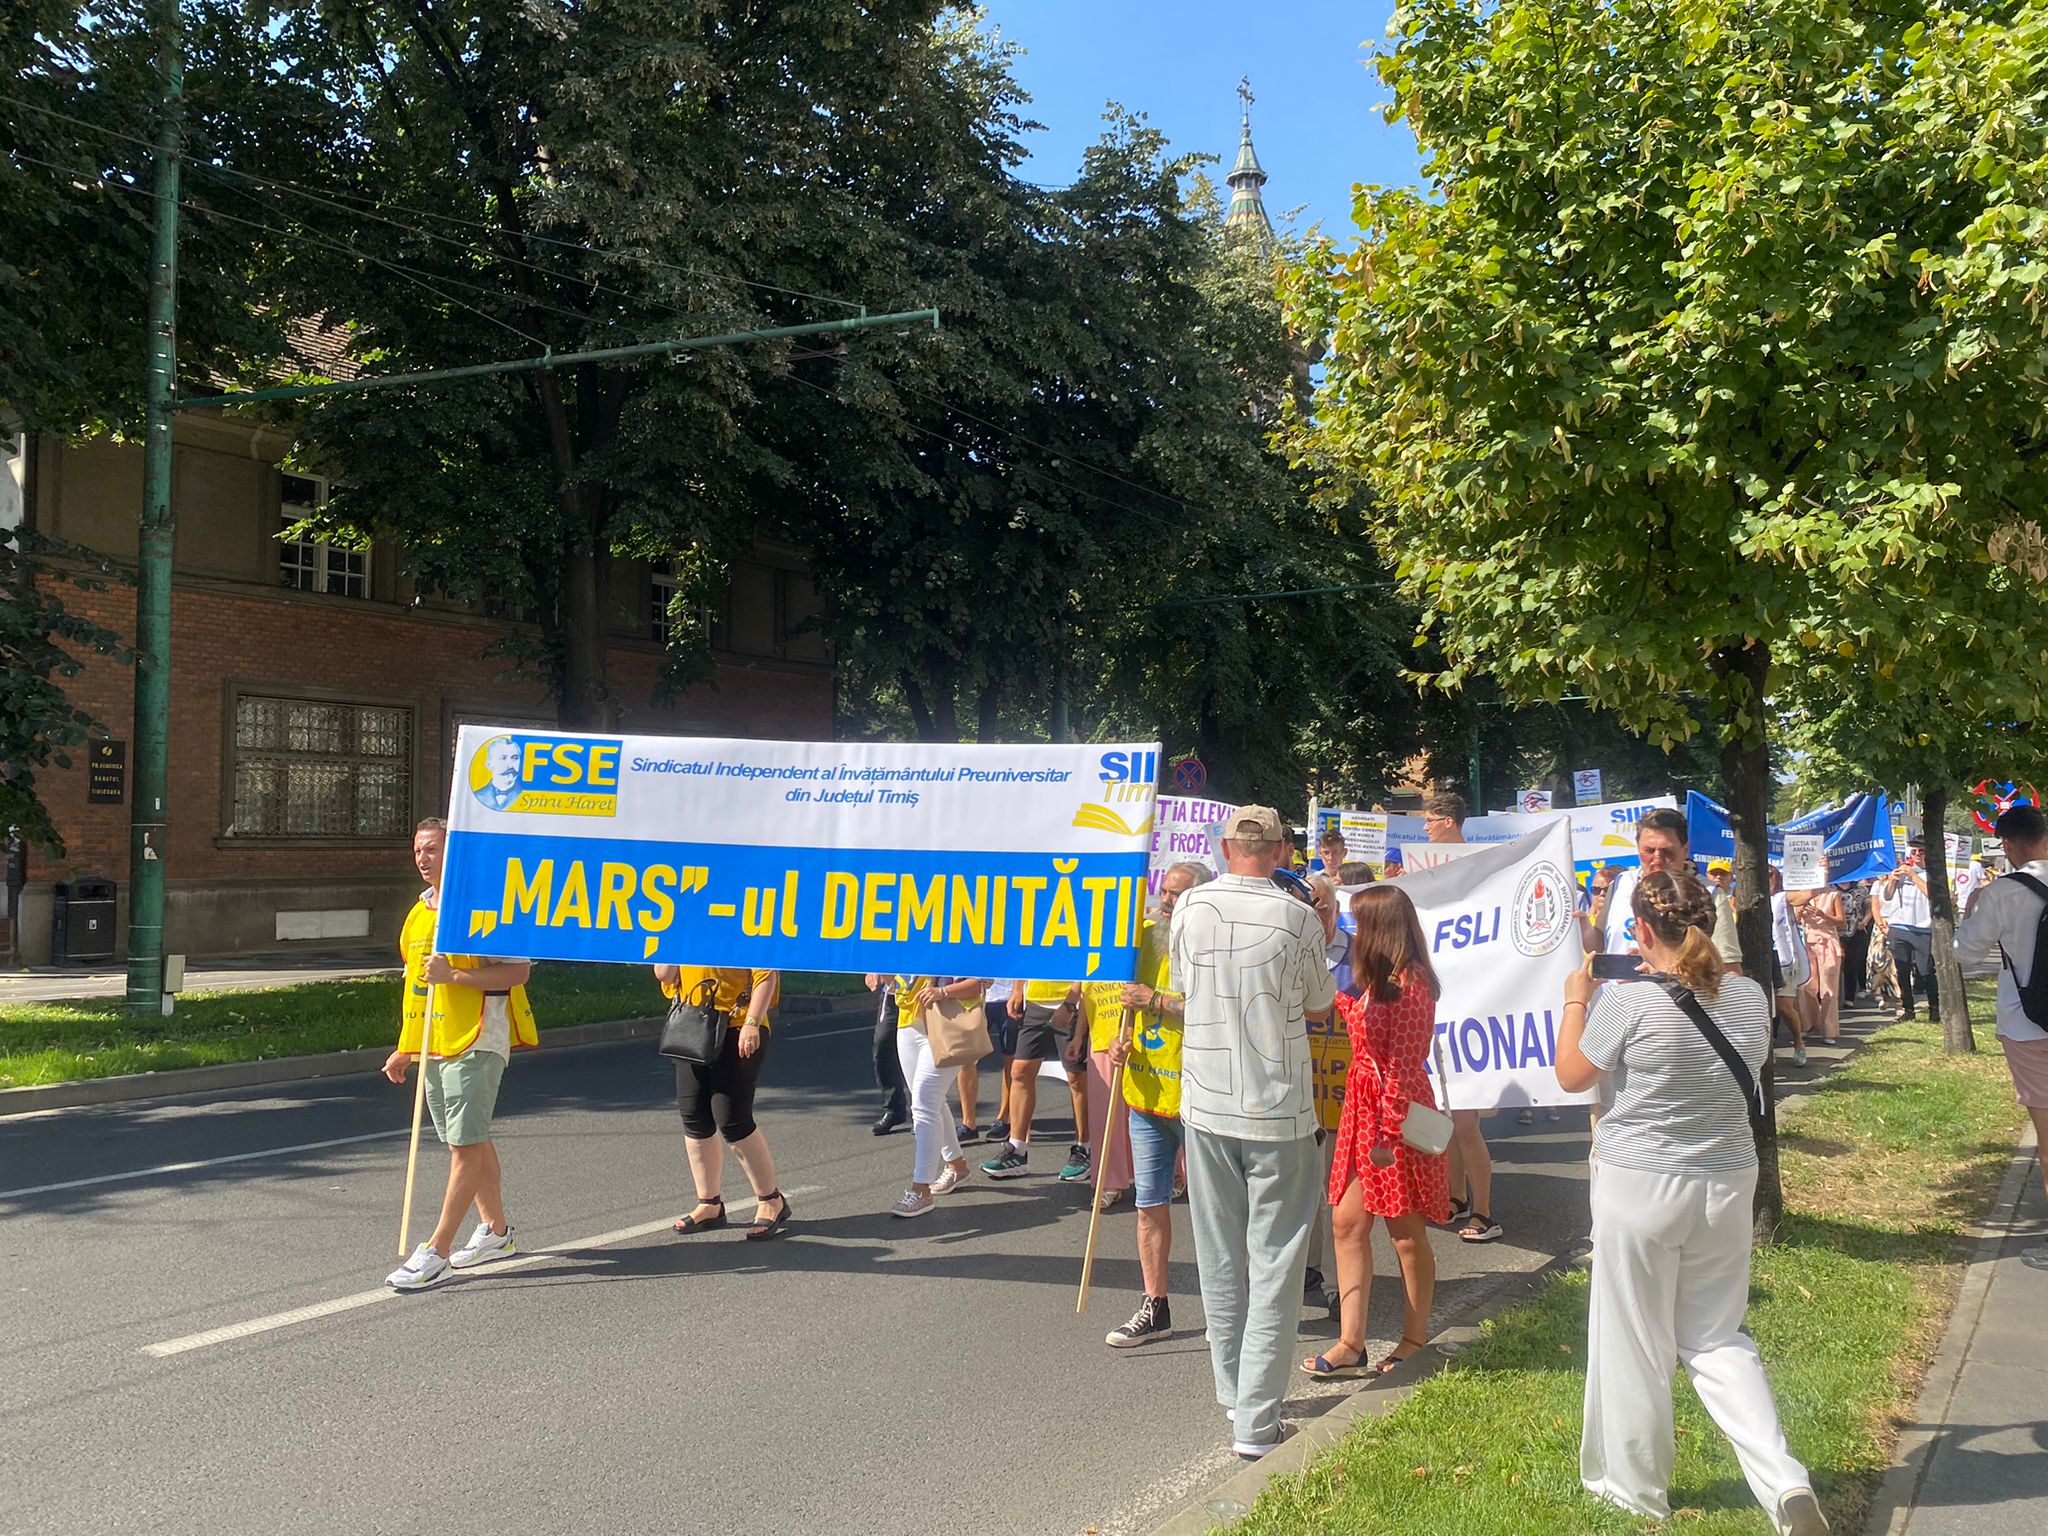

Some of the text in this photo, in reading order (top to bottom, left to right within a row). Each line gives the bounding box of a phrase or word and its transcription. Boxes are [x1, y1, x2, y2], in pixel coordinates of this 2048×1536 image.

[522, 742, 619, 785] FSE
[631, 757, 1072, 786] Sindicatul Independent al Învățământului Preuniversitar
[520, 794, 613, 811] Spiru Haret
[785, 788, 920, 808] din Județul Timiș
[1433, 906, 1501, 953] FSLI
